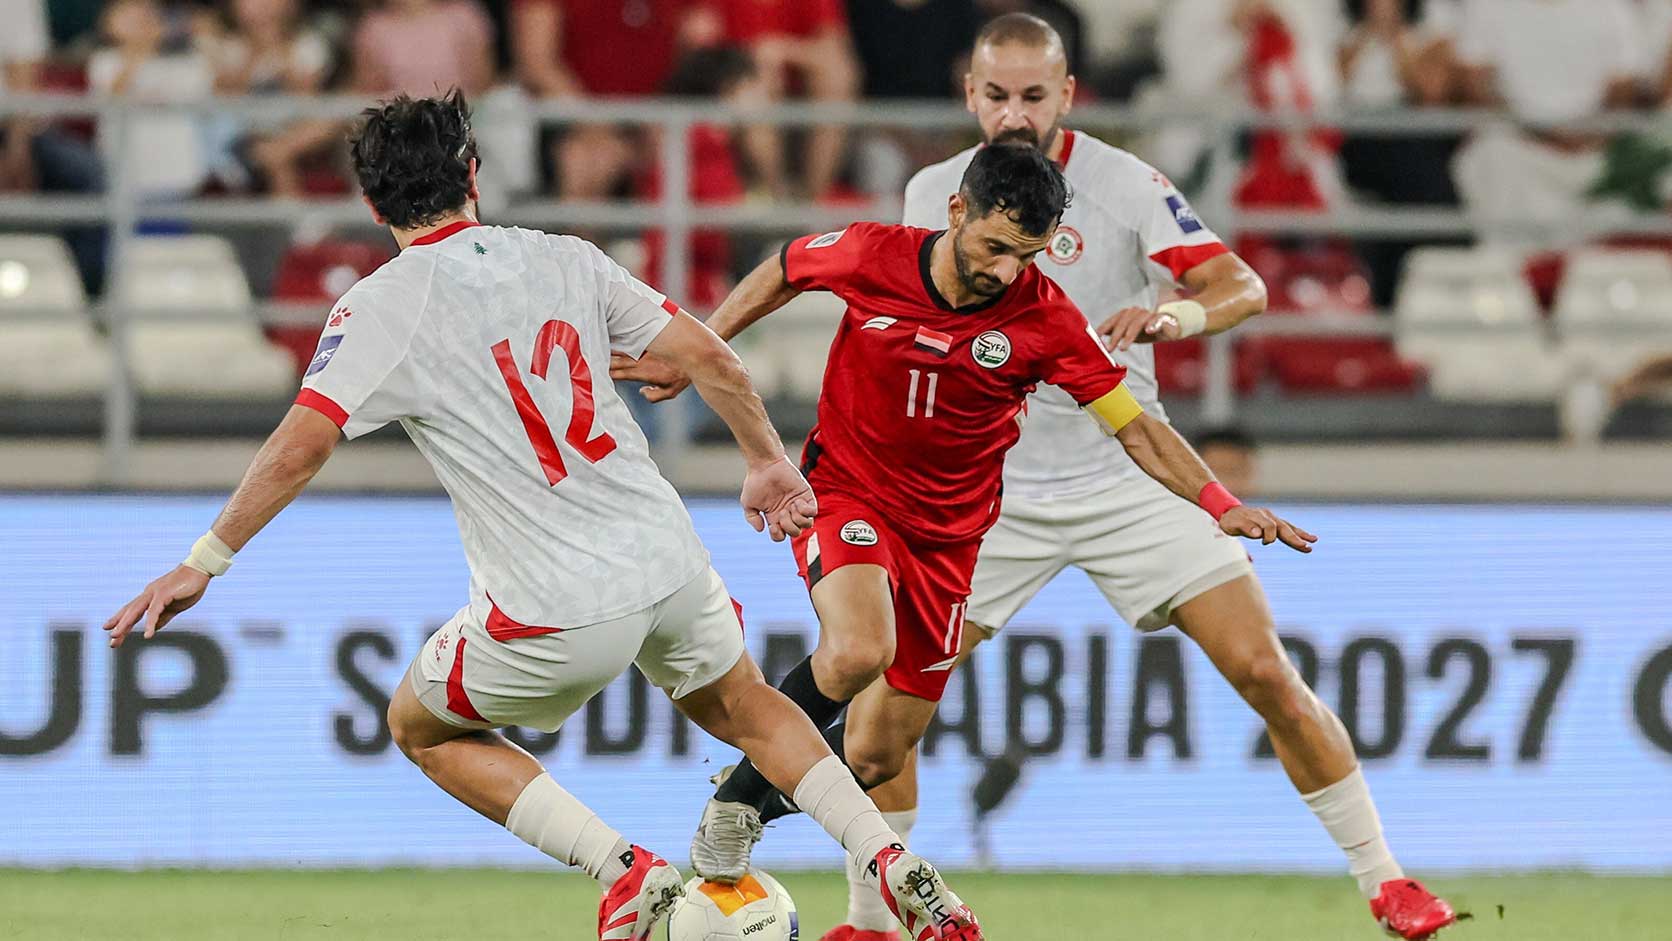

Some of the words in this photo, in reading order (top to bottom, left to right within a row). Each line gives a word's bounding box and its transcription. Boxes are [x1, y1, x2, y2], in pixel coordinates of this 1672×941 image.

[990, 343, 1006, 354] YFA
[490, 319, 618, 488] 12
[906, 369, 939, 418] 11
[944, 601, 968, 654] 11
[742, 914, 777, 936] molten
